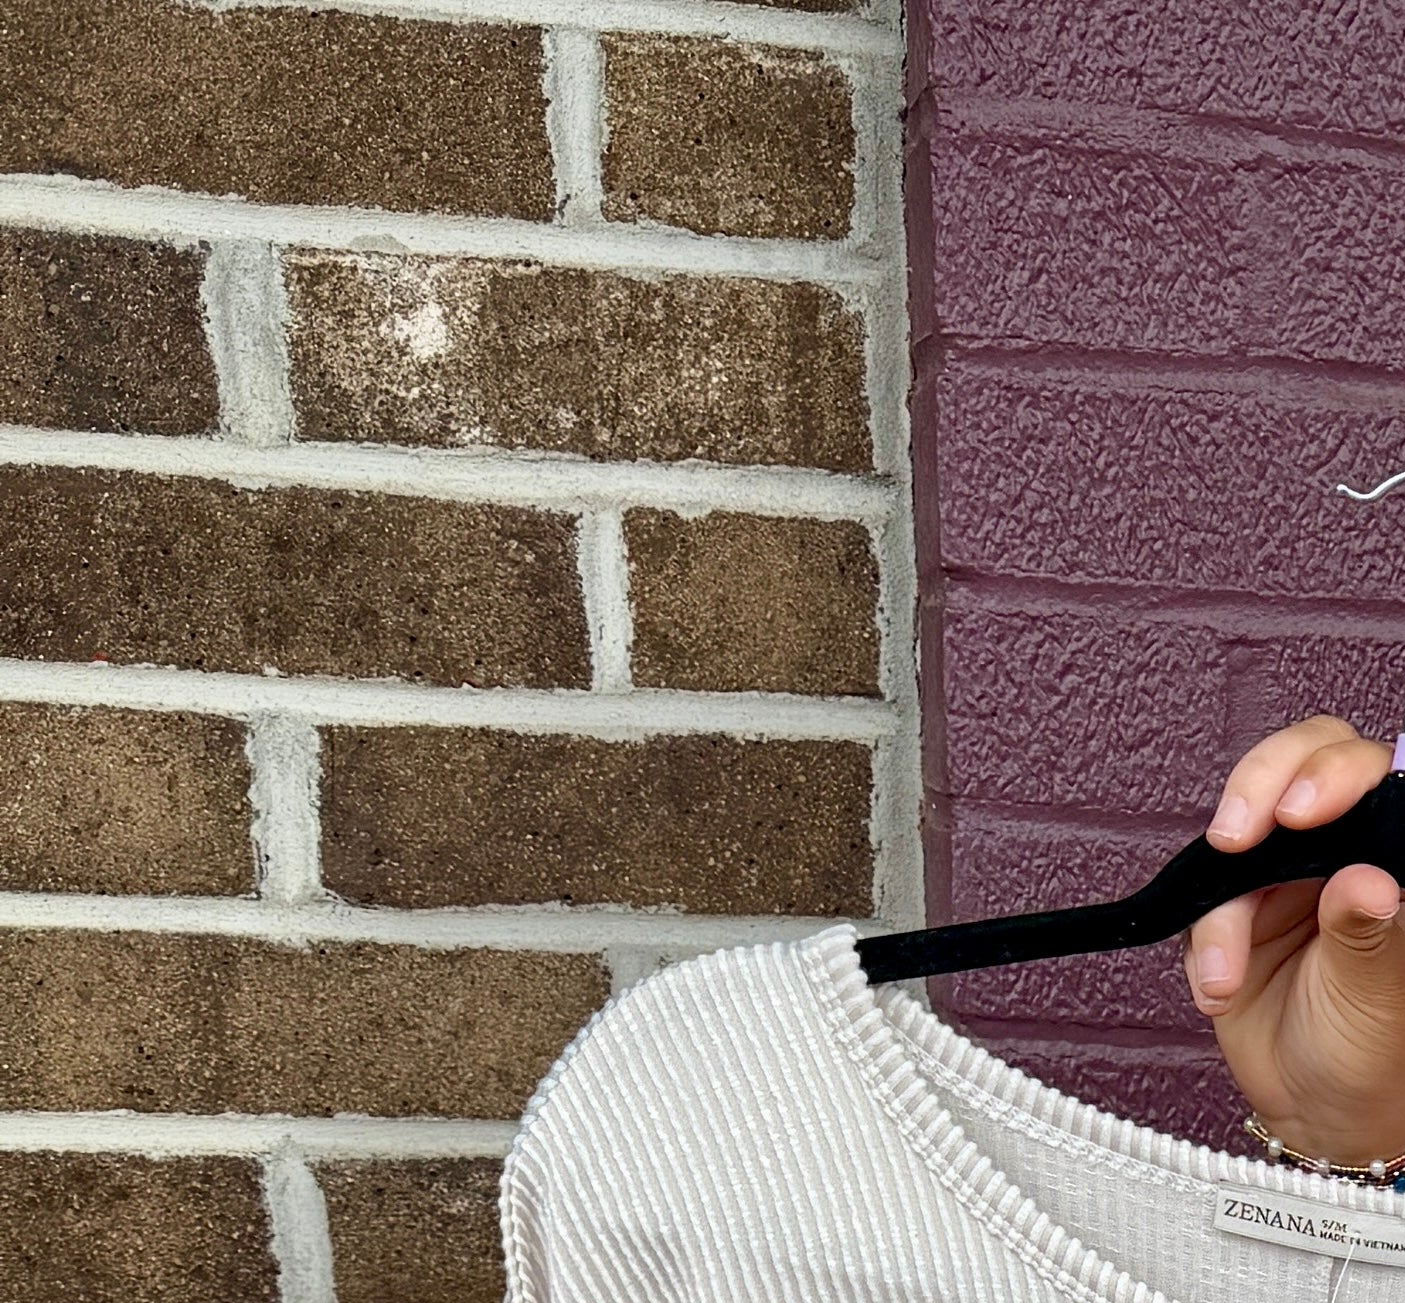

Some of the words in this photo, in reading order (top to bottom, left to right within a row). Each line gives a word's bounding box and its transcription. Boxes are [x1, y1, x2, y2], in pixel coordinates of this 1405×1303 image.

[1224, 1199, 1317, 1238] ZENANA
[1321, 1219, 1348, 1233] S/M
[1319, 1230, 1347, 1244] MADE
[1350, 1236, 1361, 1246] IN
